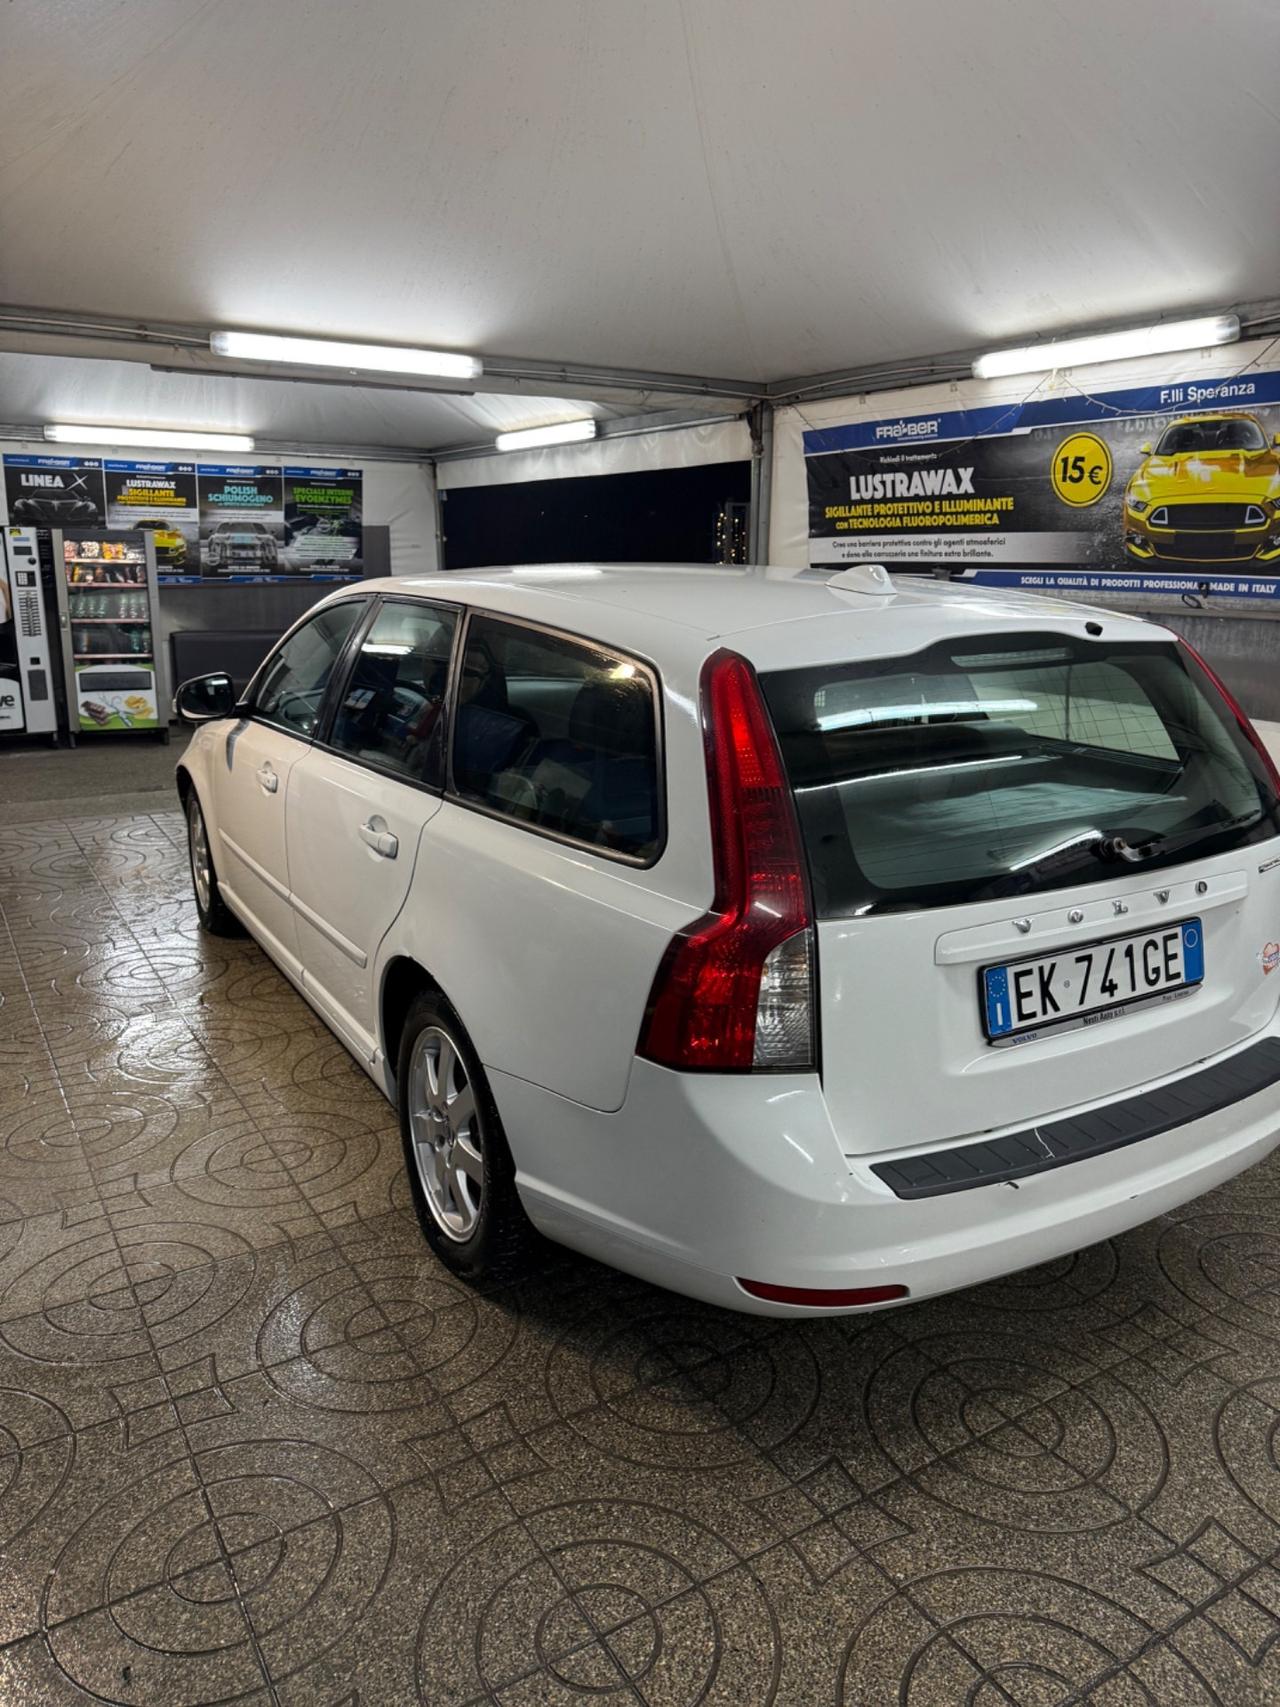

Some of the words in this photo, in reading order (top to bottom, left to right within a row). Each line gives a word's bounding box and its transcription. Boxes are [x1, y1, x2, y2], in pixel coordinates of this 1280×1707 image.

[1187, 382, 1256, 406] Speranza
[20, 473, 66, 489] LINEA
[126, 479, 176, 489] LUSTRAWAX
[849, 467, 976, 500] LUSTRAWAX
[128, 488, 175, 497] SIGILLANTE
[207, 493, 274, 503] SCHIUMOGENO
[223, 485, 258, 495] POLISH
[825, 505, 872, 519] SIGILLANTE
[873, 502, 931, 516] PROTETTIVO
[934, 502, 940, 513] E
[942, 497, 1015, 513] ILLUMINANTE
[849, 517, 901, 529] TECNOLOGIA
[902, 513, 1000, 528] FLUOROPOLIMERICA
[913, 539, 932, 547] contro
[934, 538, 942, 549] gli
[944, 538, 965, 549] agenti
[966, 536, 1006, 546] atmosferici
[1045, 576, 1055, 585] LA
[1057, 575, 1088, 586] QUALITÀ
[1090, 578, 1099, 586] DI
[1101, 578, 1141, 588] PRODOTTI
[1209, 582, 1235, 592] MADE
[1238, 583, 1249, 593] IN
[1252, 584, 1277, 594] ITALY
[1011, 880, 1209, 934] VOLVO
[1013, 962, 1061, 1022] EK
[1074, 932, 1182, 1006] 741GE
